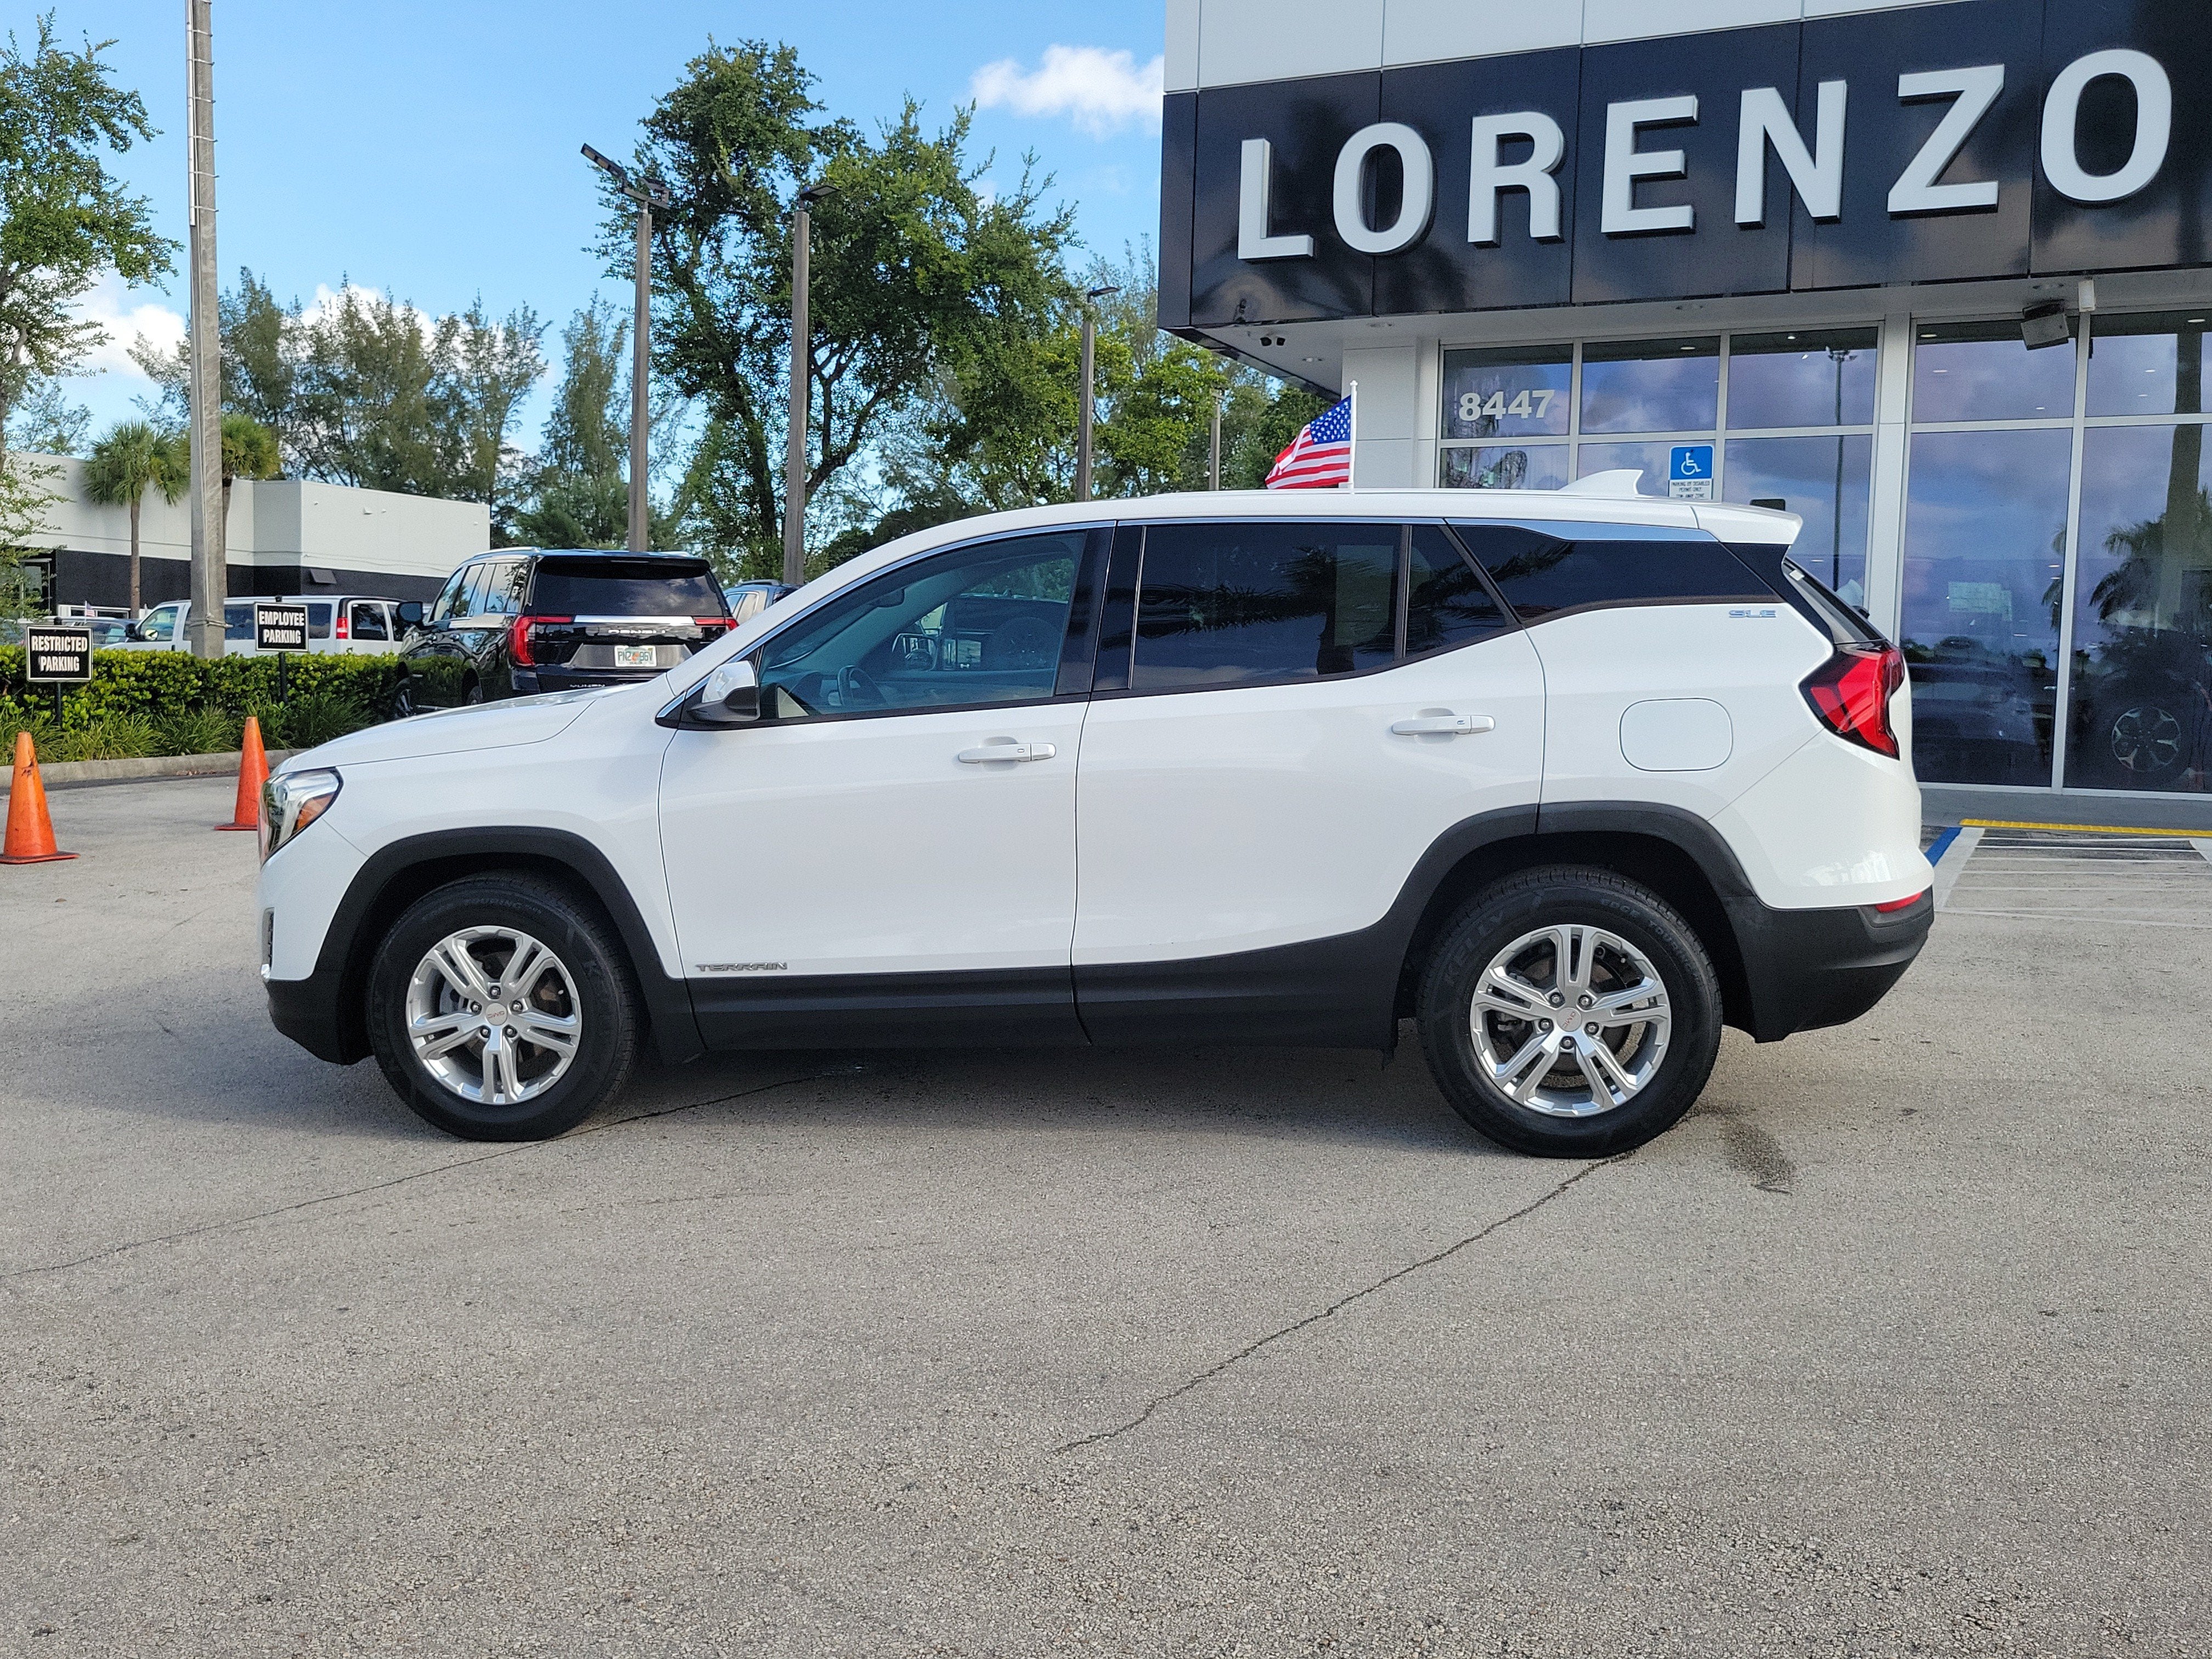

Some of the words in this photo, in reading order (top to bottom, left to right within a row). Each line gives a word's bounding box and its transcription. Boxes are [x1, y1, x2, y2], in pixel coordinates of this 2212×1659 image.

[1237, 49, 2172, 262] LORENZO
[1458, 389, 1555, 421] 8447
[258, 610, 304, 627] EMPLOYEE
[1729, 610, 1777, 618] SLE
[31, 635, 88, 652] RESTRICTED
[263, 629, 301, 645] PARKING
[40, 656, 80, 672] PARKING
[695, 961, 788, 972] TERRAIN
